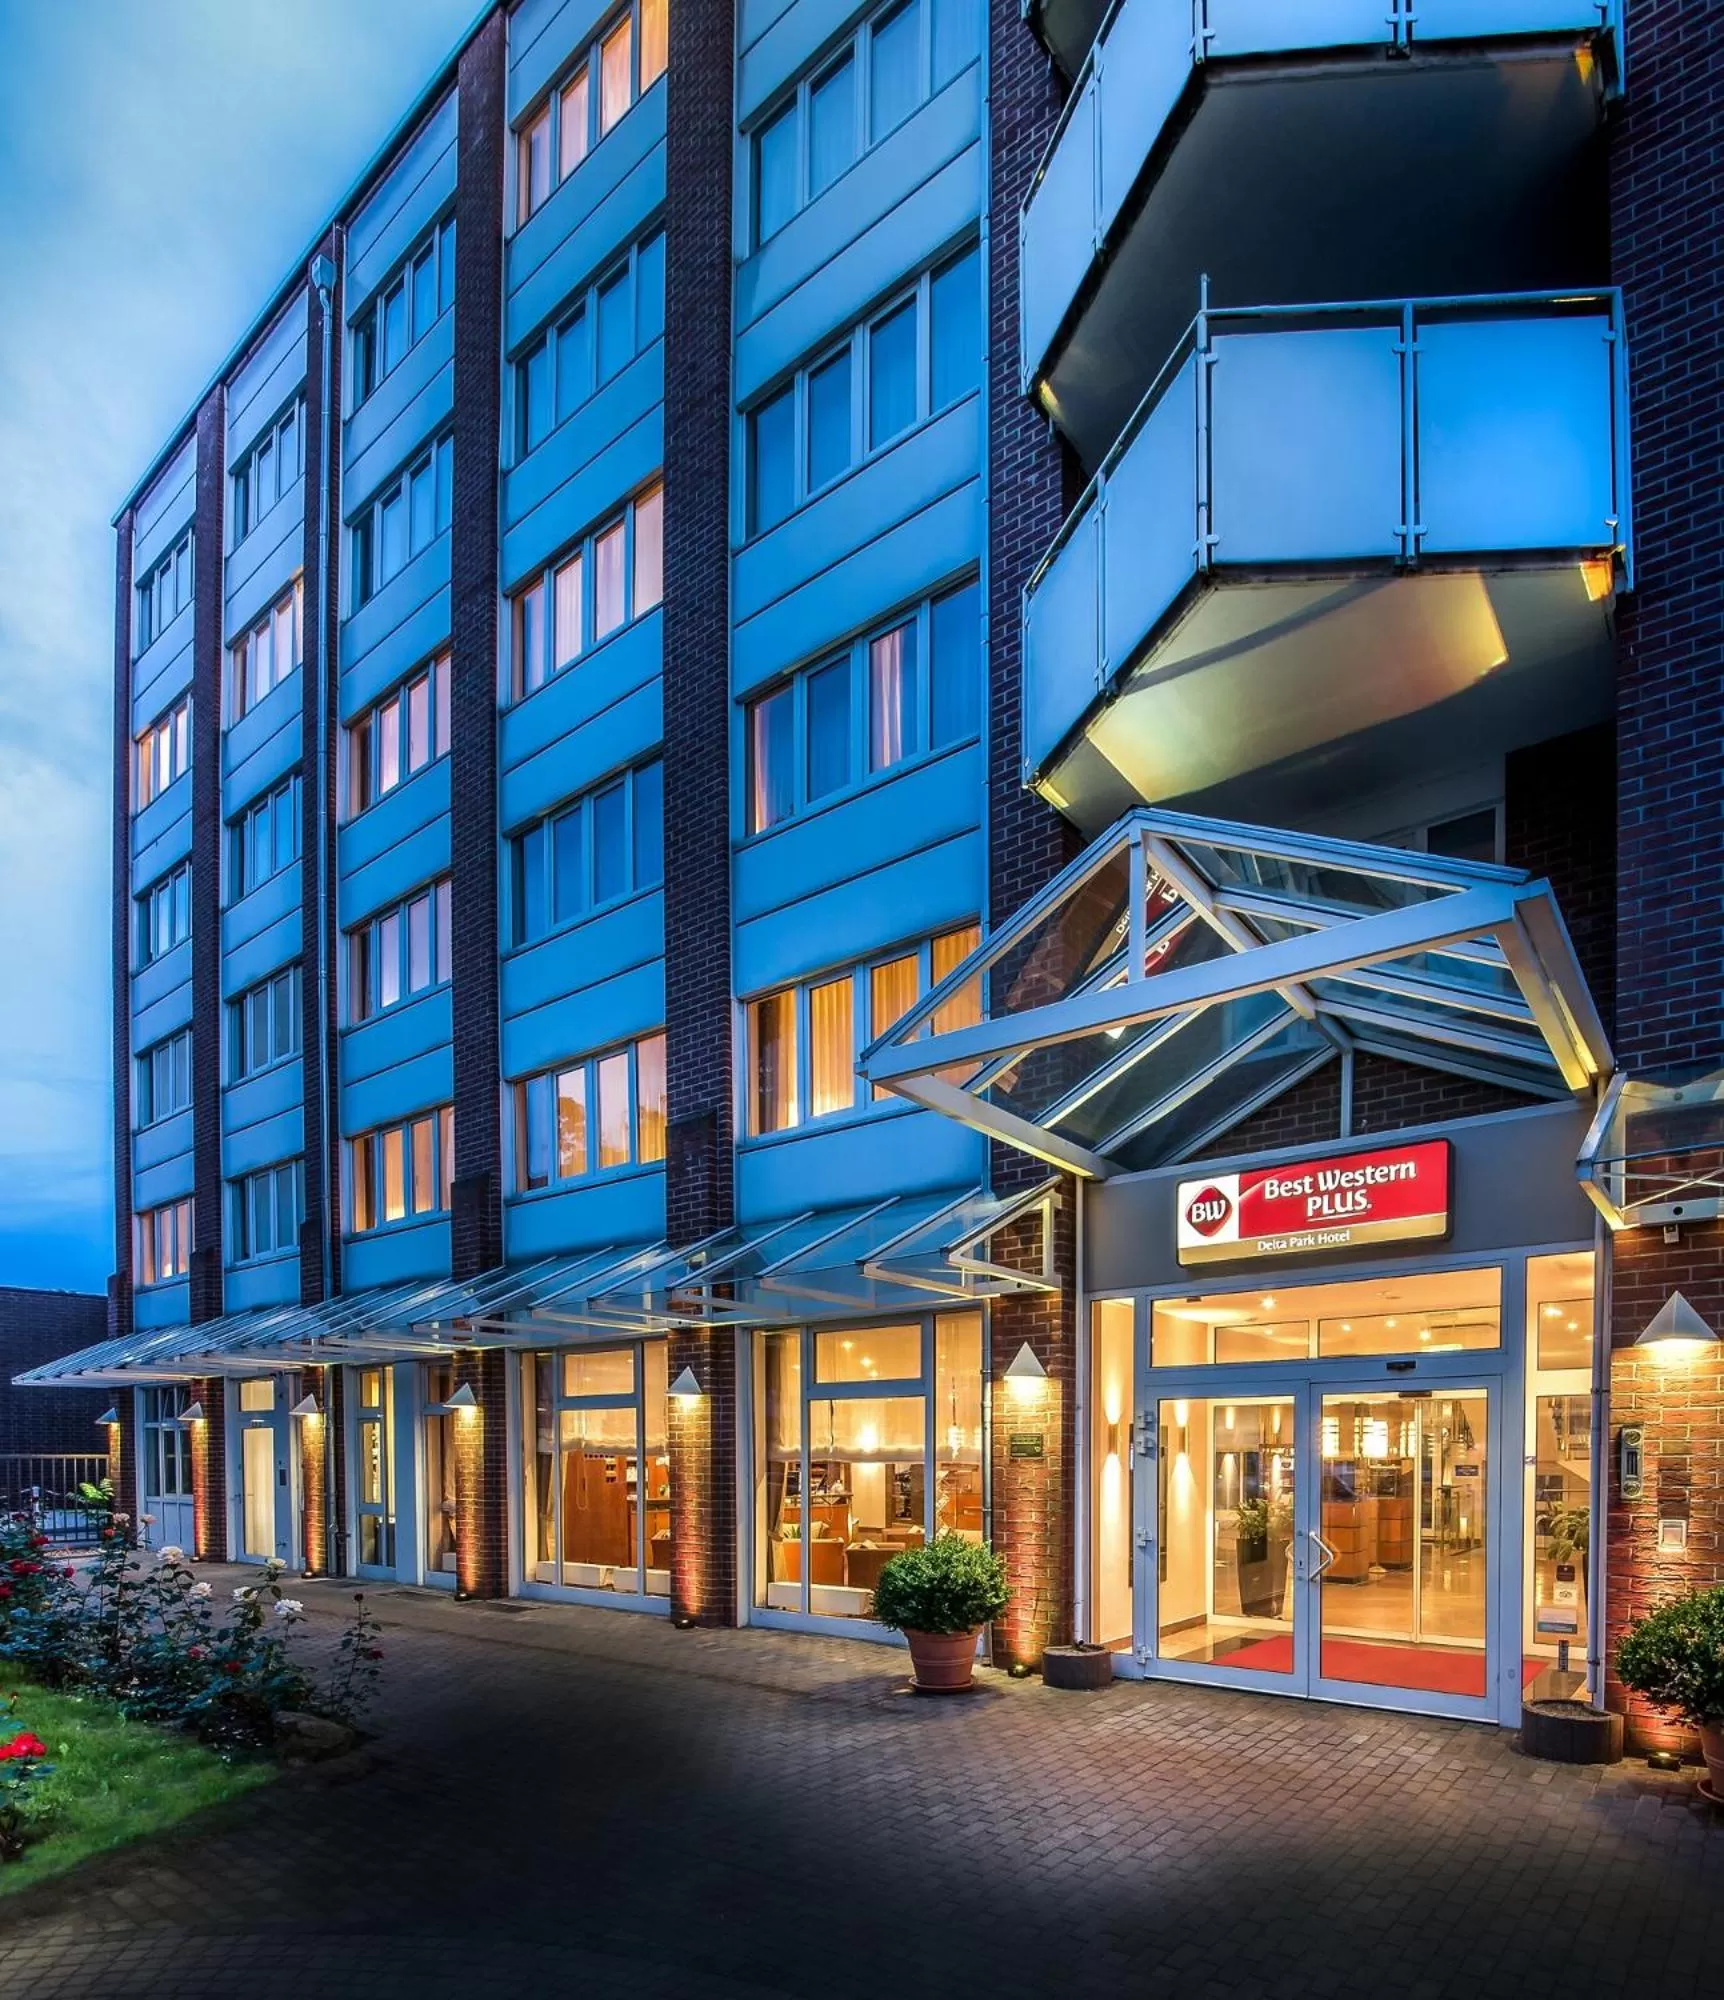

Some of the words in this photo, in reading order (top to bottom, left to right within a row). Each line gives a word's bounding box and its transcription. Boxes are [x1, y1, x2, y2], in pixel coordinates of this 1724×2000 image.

[1264, 1175, 1314, 1200] Best
[1317, 1160, 1417, 1192] Western
[1191, 1199, 1226, 1224] BW
[1257, 1239, 1288, 1252] Delta
[1289, 1233, 1315, 1248] Park
[1317, 1229, 1350, 1245] Hotel
